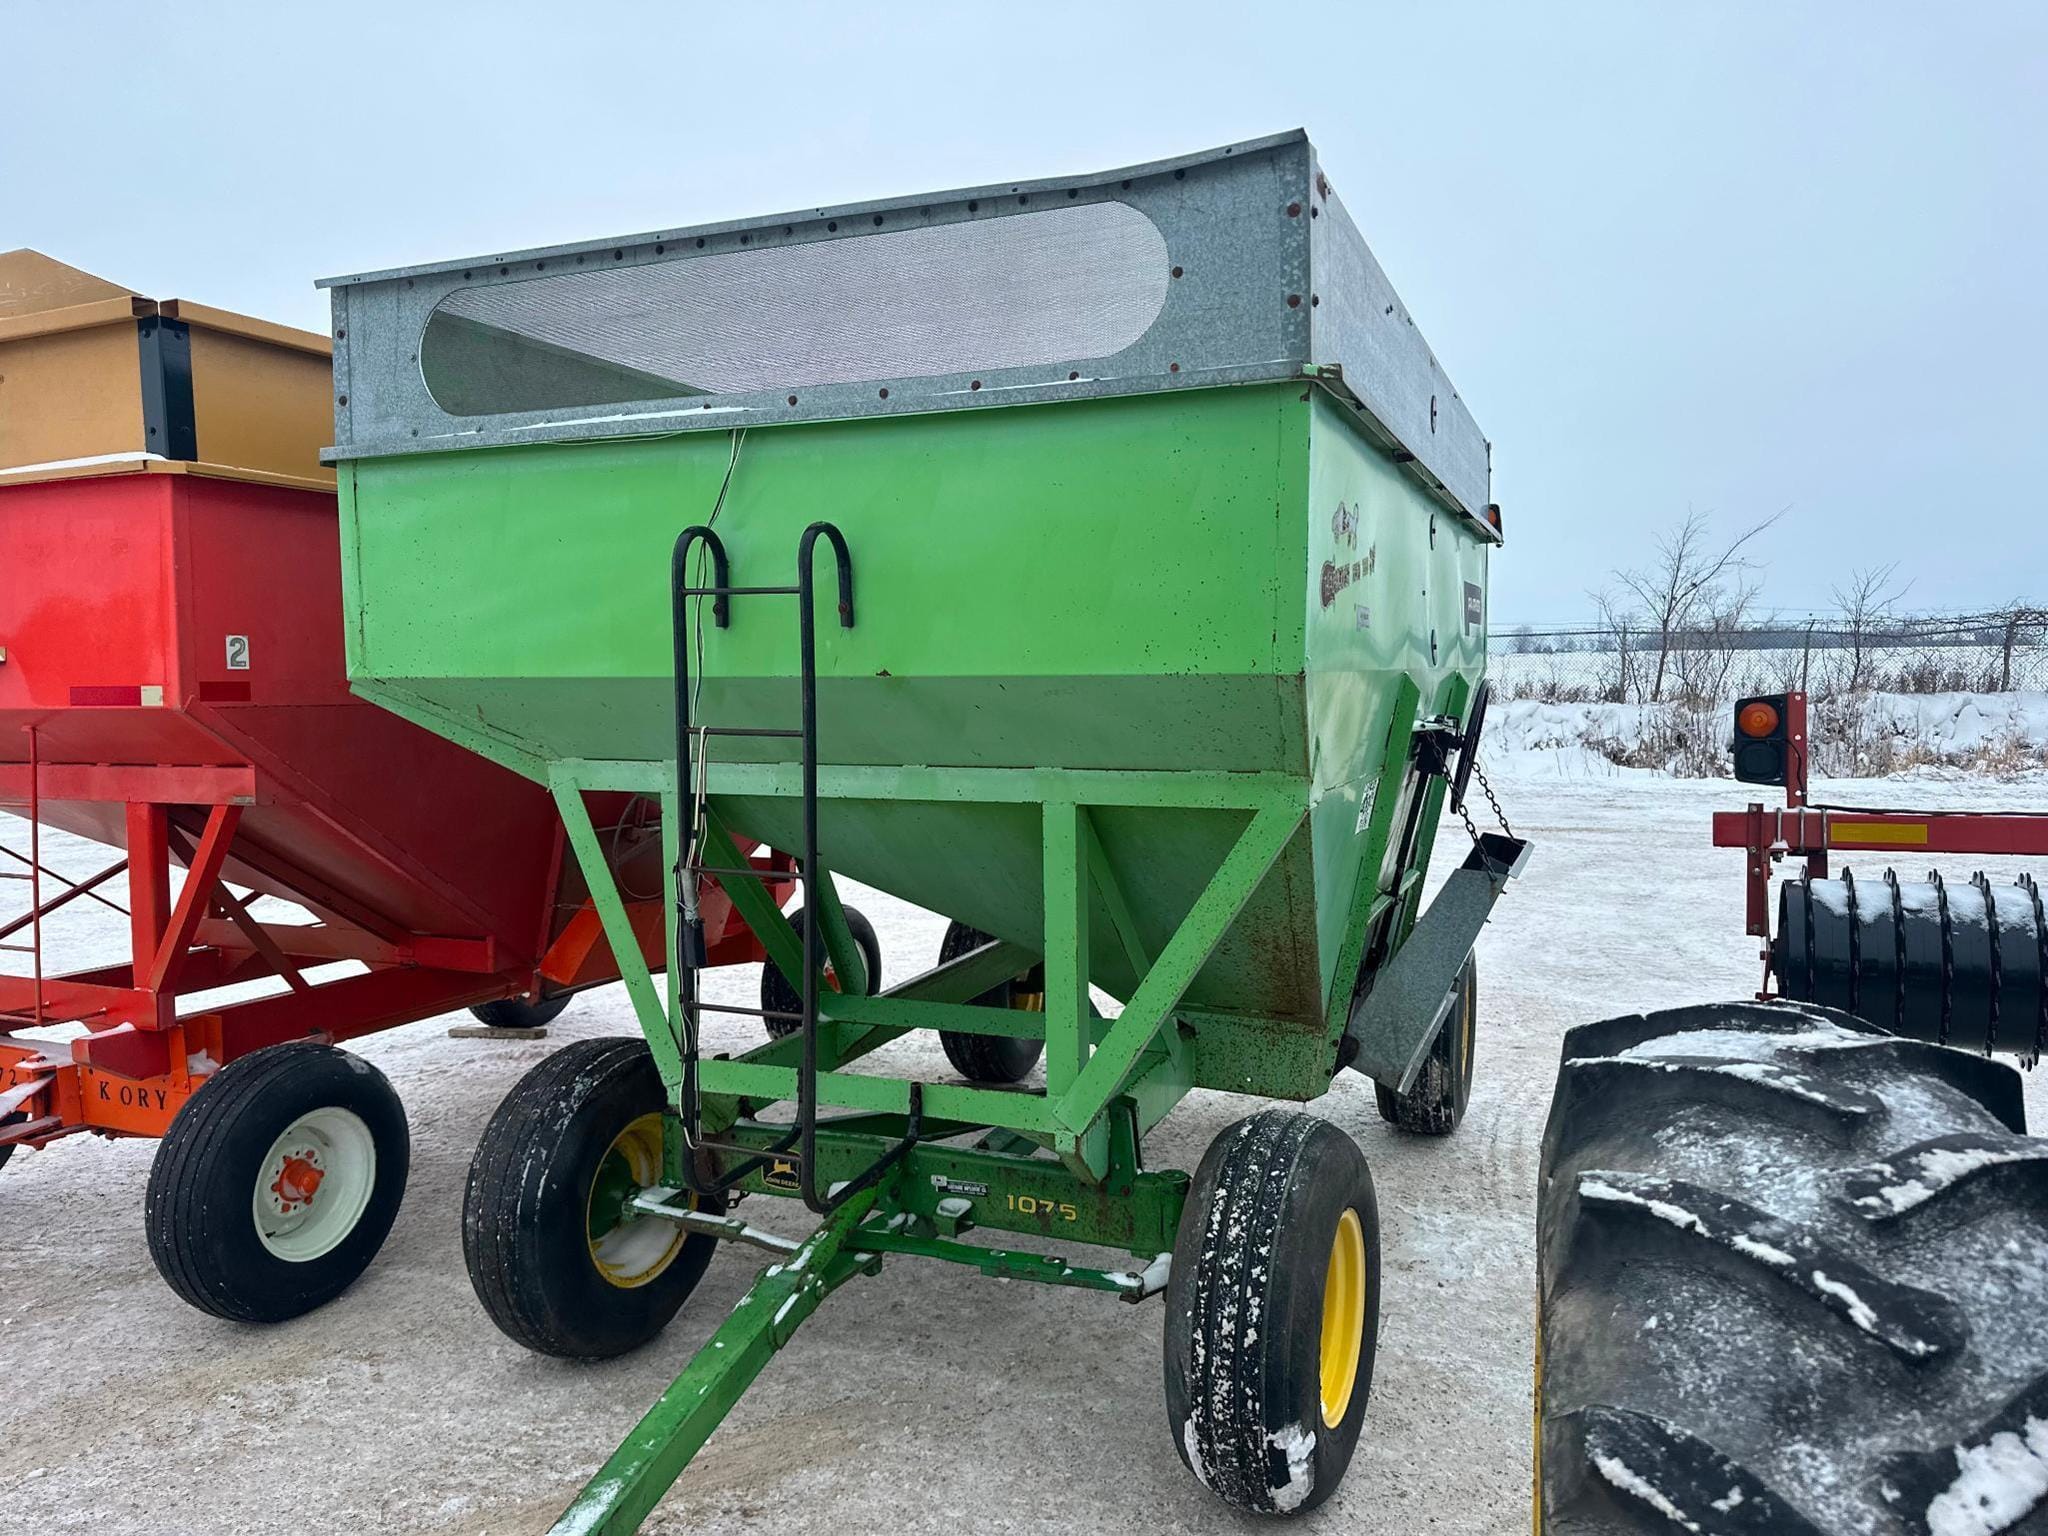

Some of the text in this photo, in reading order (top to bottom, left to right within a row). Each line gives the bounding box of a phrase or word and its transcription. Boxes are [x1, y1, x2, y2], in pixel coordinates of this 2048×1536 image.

[230, 637, 247, 667] 2
[100, 1080, 167, 1110] KORY
[765, 1176, 781, 1185] JOHN
[1007, 1194, 1077, 1221] 1075
